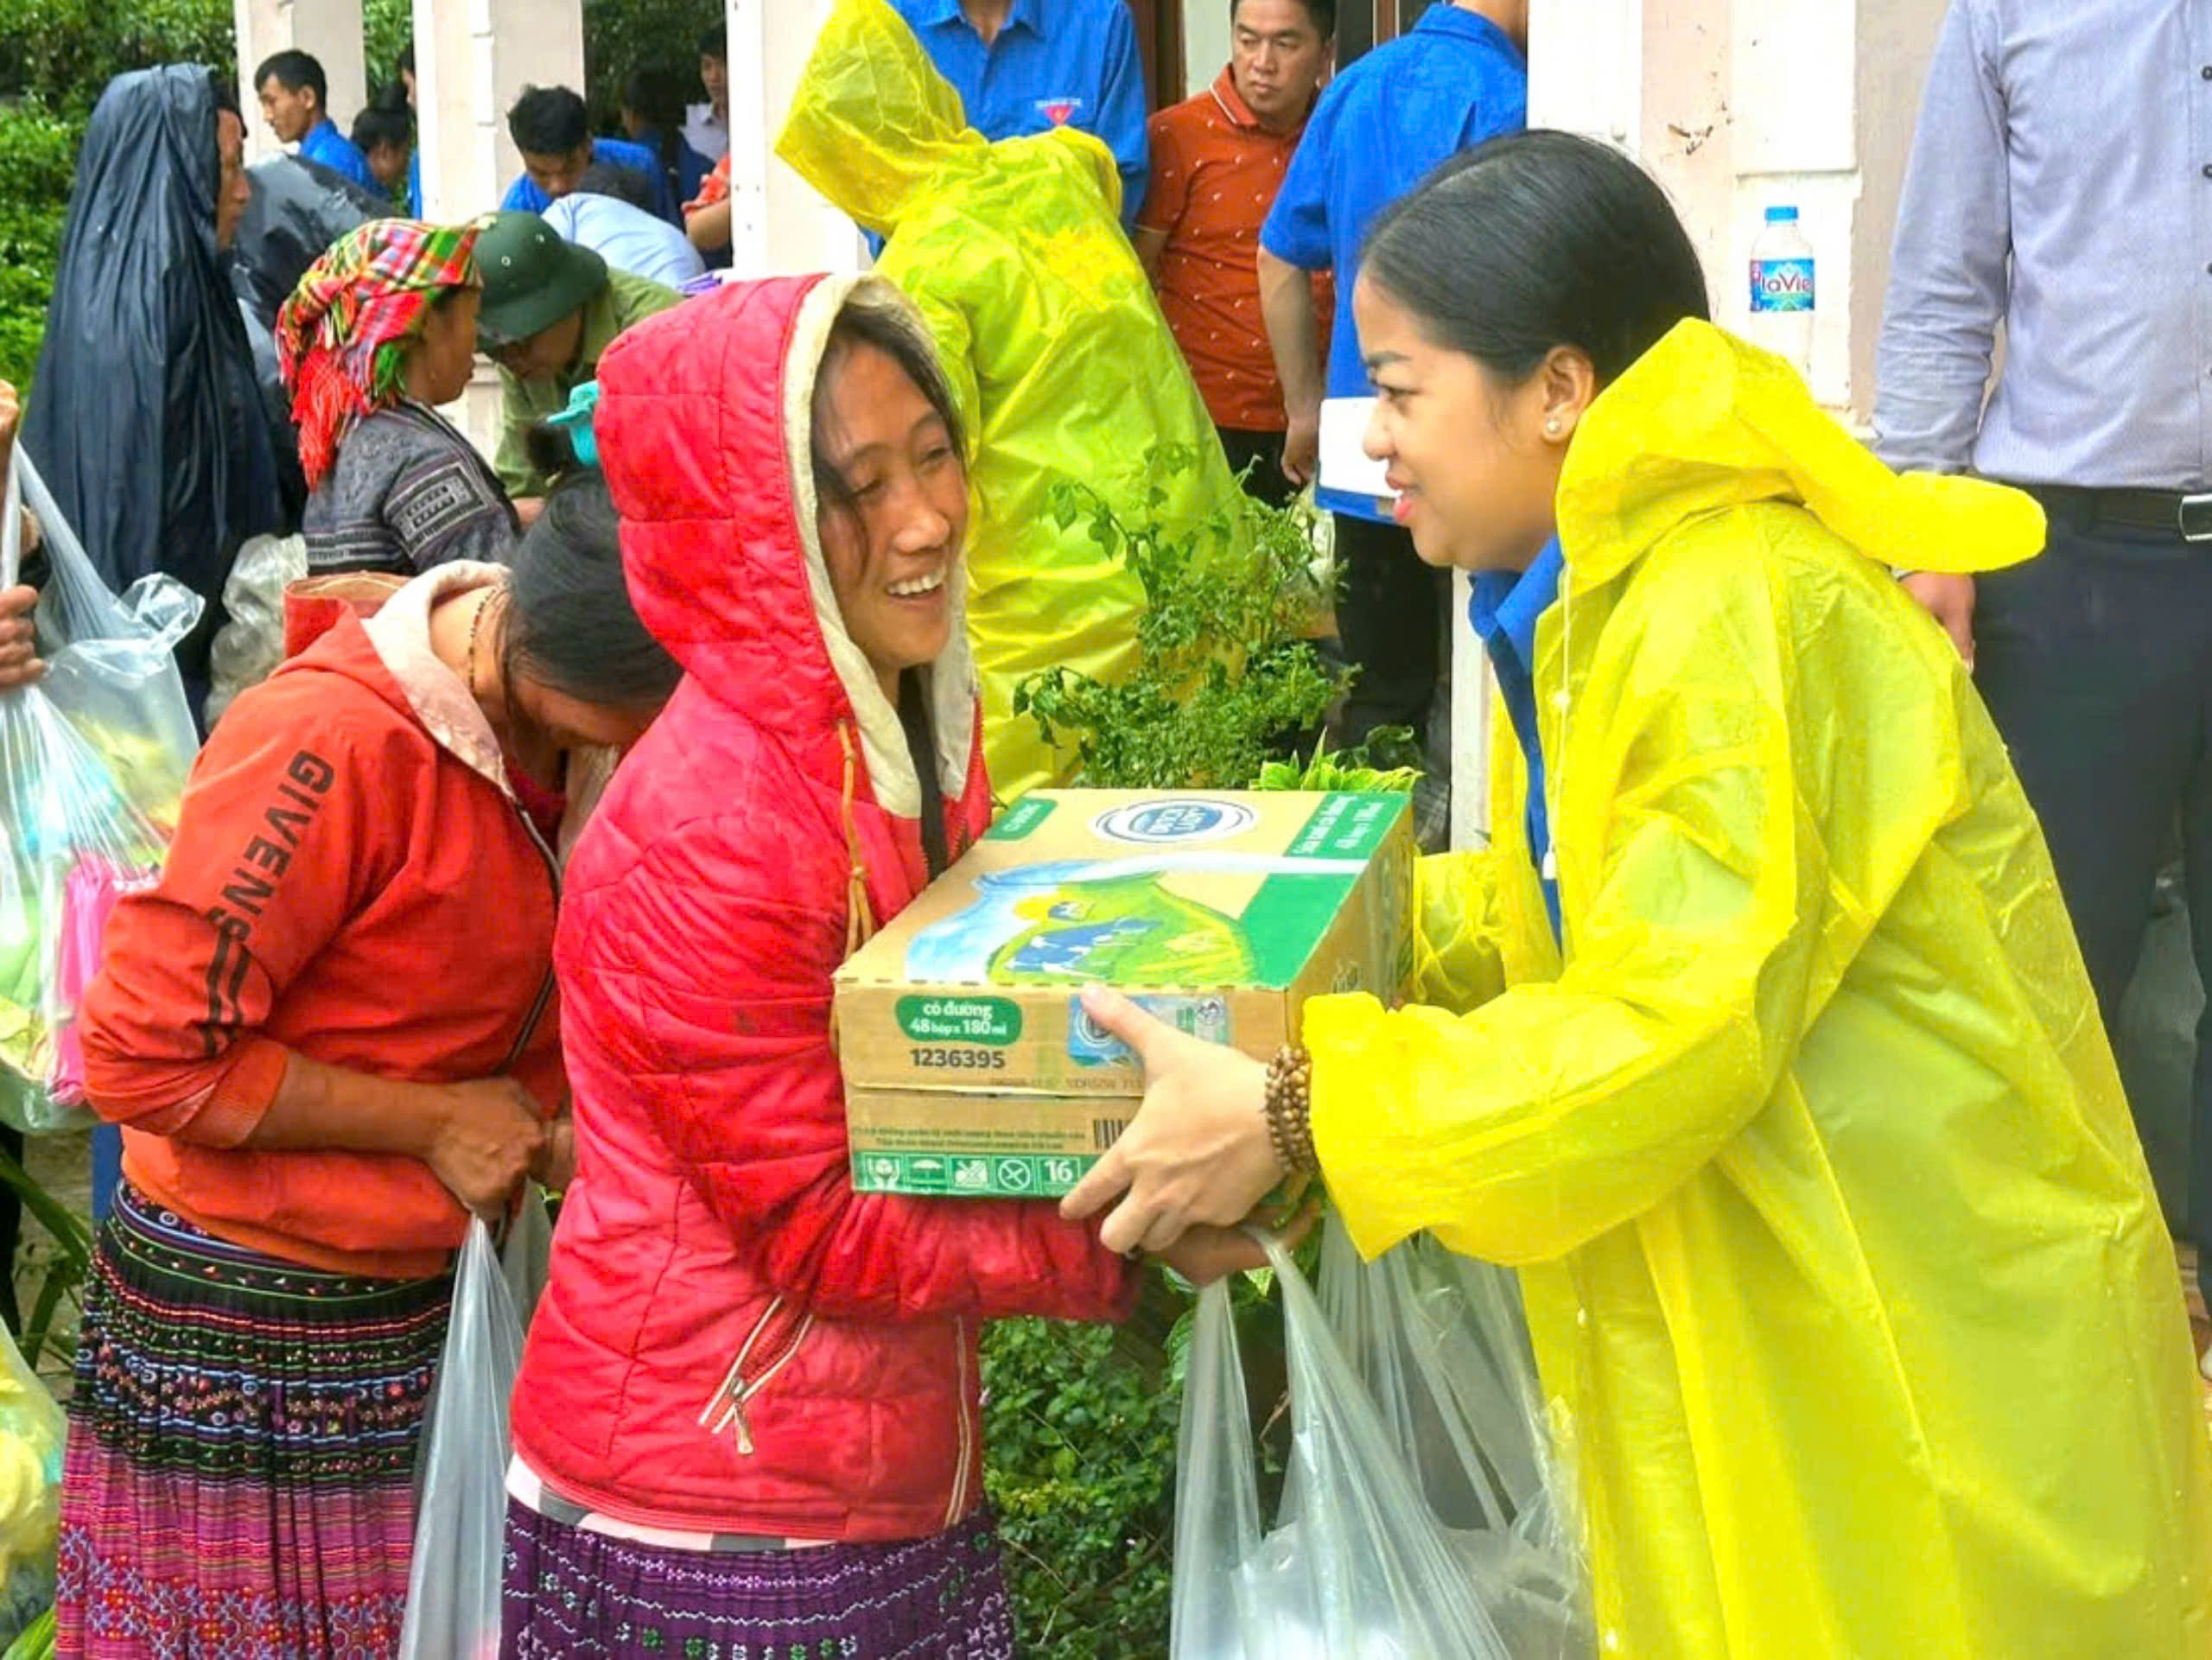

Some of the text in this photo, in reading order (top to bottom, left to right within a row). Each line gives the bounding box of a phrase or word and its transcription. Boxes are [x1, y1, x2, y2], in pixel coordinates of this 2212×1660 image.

[910, 1018, 931, 1034] 48
[910, 1048, 1005, 1068] 1236395
[1044, 1159, 1073, 1183] 16
